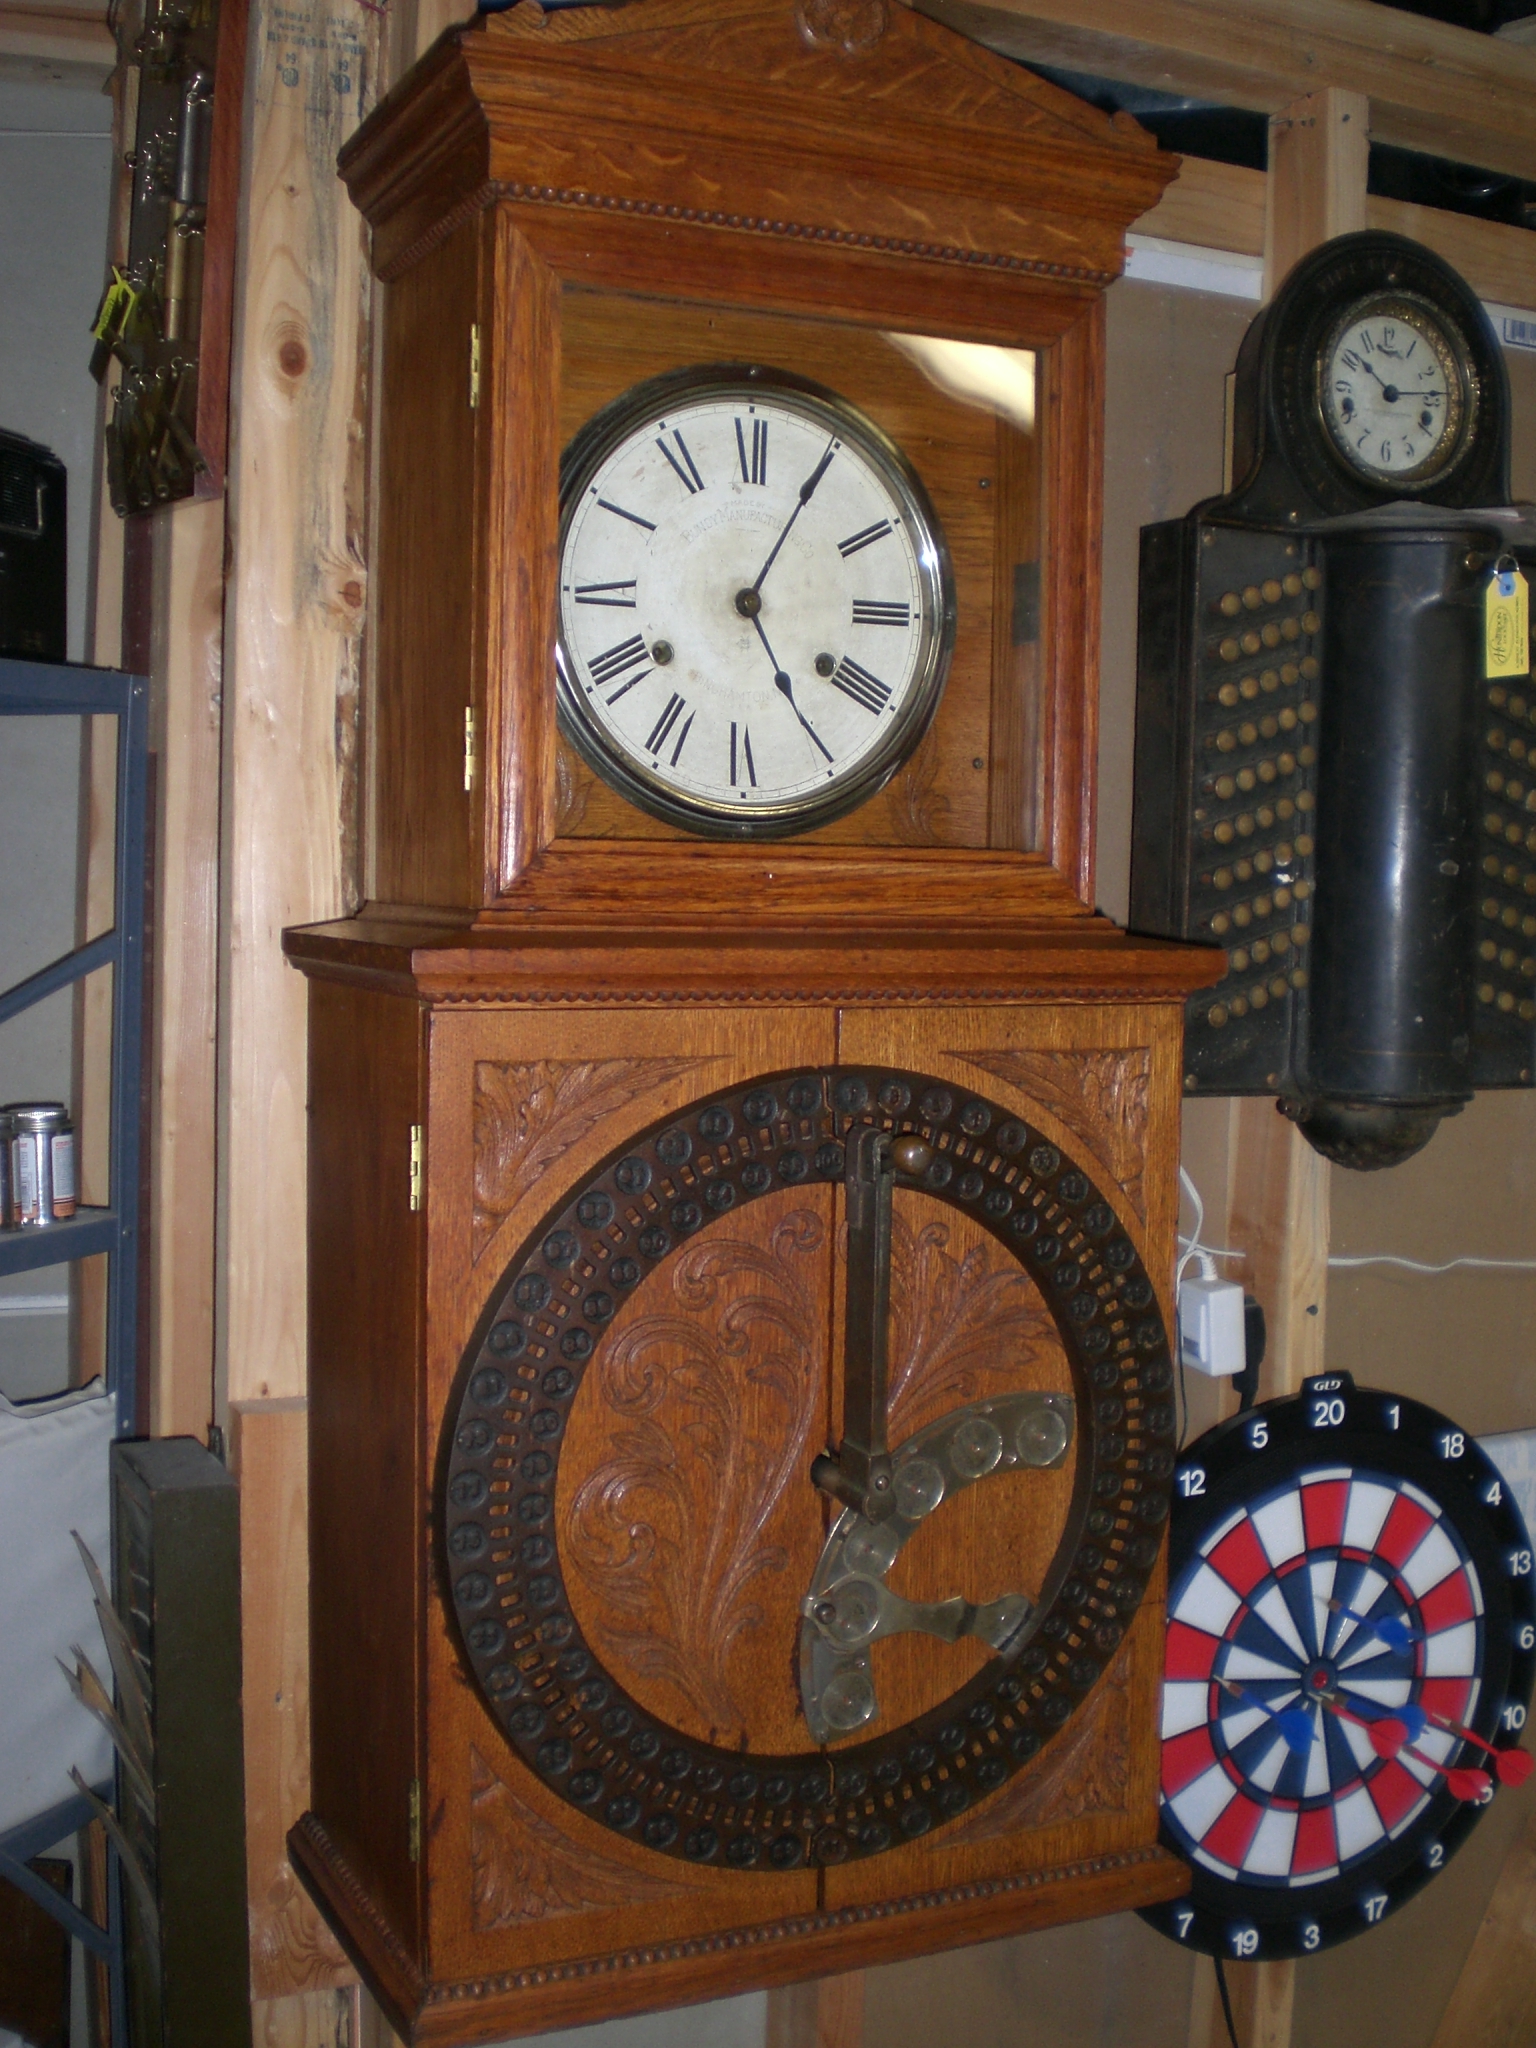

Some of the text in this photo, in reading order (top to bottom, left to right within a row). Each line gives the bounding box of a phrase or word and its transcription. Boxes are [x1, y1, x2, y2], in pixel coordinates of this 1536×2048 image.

[1335, 379, 1352, 394] 9
[1357, 427, 1371, 449] 7
[1381, 439, 1391, 463] 6
[836, 517, 894, 560] II
[852, 599, 910, 627] III
[586, 633, 656, 707] VIII
[830, 654, 893, 717] IIII
[644, 692, 697, 768] VII
[1313, 1380, 1342, 1391] GLD
[1314, 1399, 1345, 1427] 20
[1390, 1405, 1400, 1430] 1
[1252, 1422, 1269, 1449] 5
[1441, 1433, 1465, 1458] 18
[1180, 1470, 1206, 1497] 12
[1486, 1481, 1502, 1506] 4
[1509, 1550, 1532, 1576] 13
[1520, 1625, 1535, 1649] 6
[1503, 1704, 1527, 1730] 10
[1429, 1844, 1444, 1868] 2
[1365, 1895, 1389, 1922] 17
[1178, 1912, 1194, 1938] 7
[1303, 1925, 1320, 1949] 3
[1232, 1929, 1259, 1956] 19
